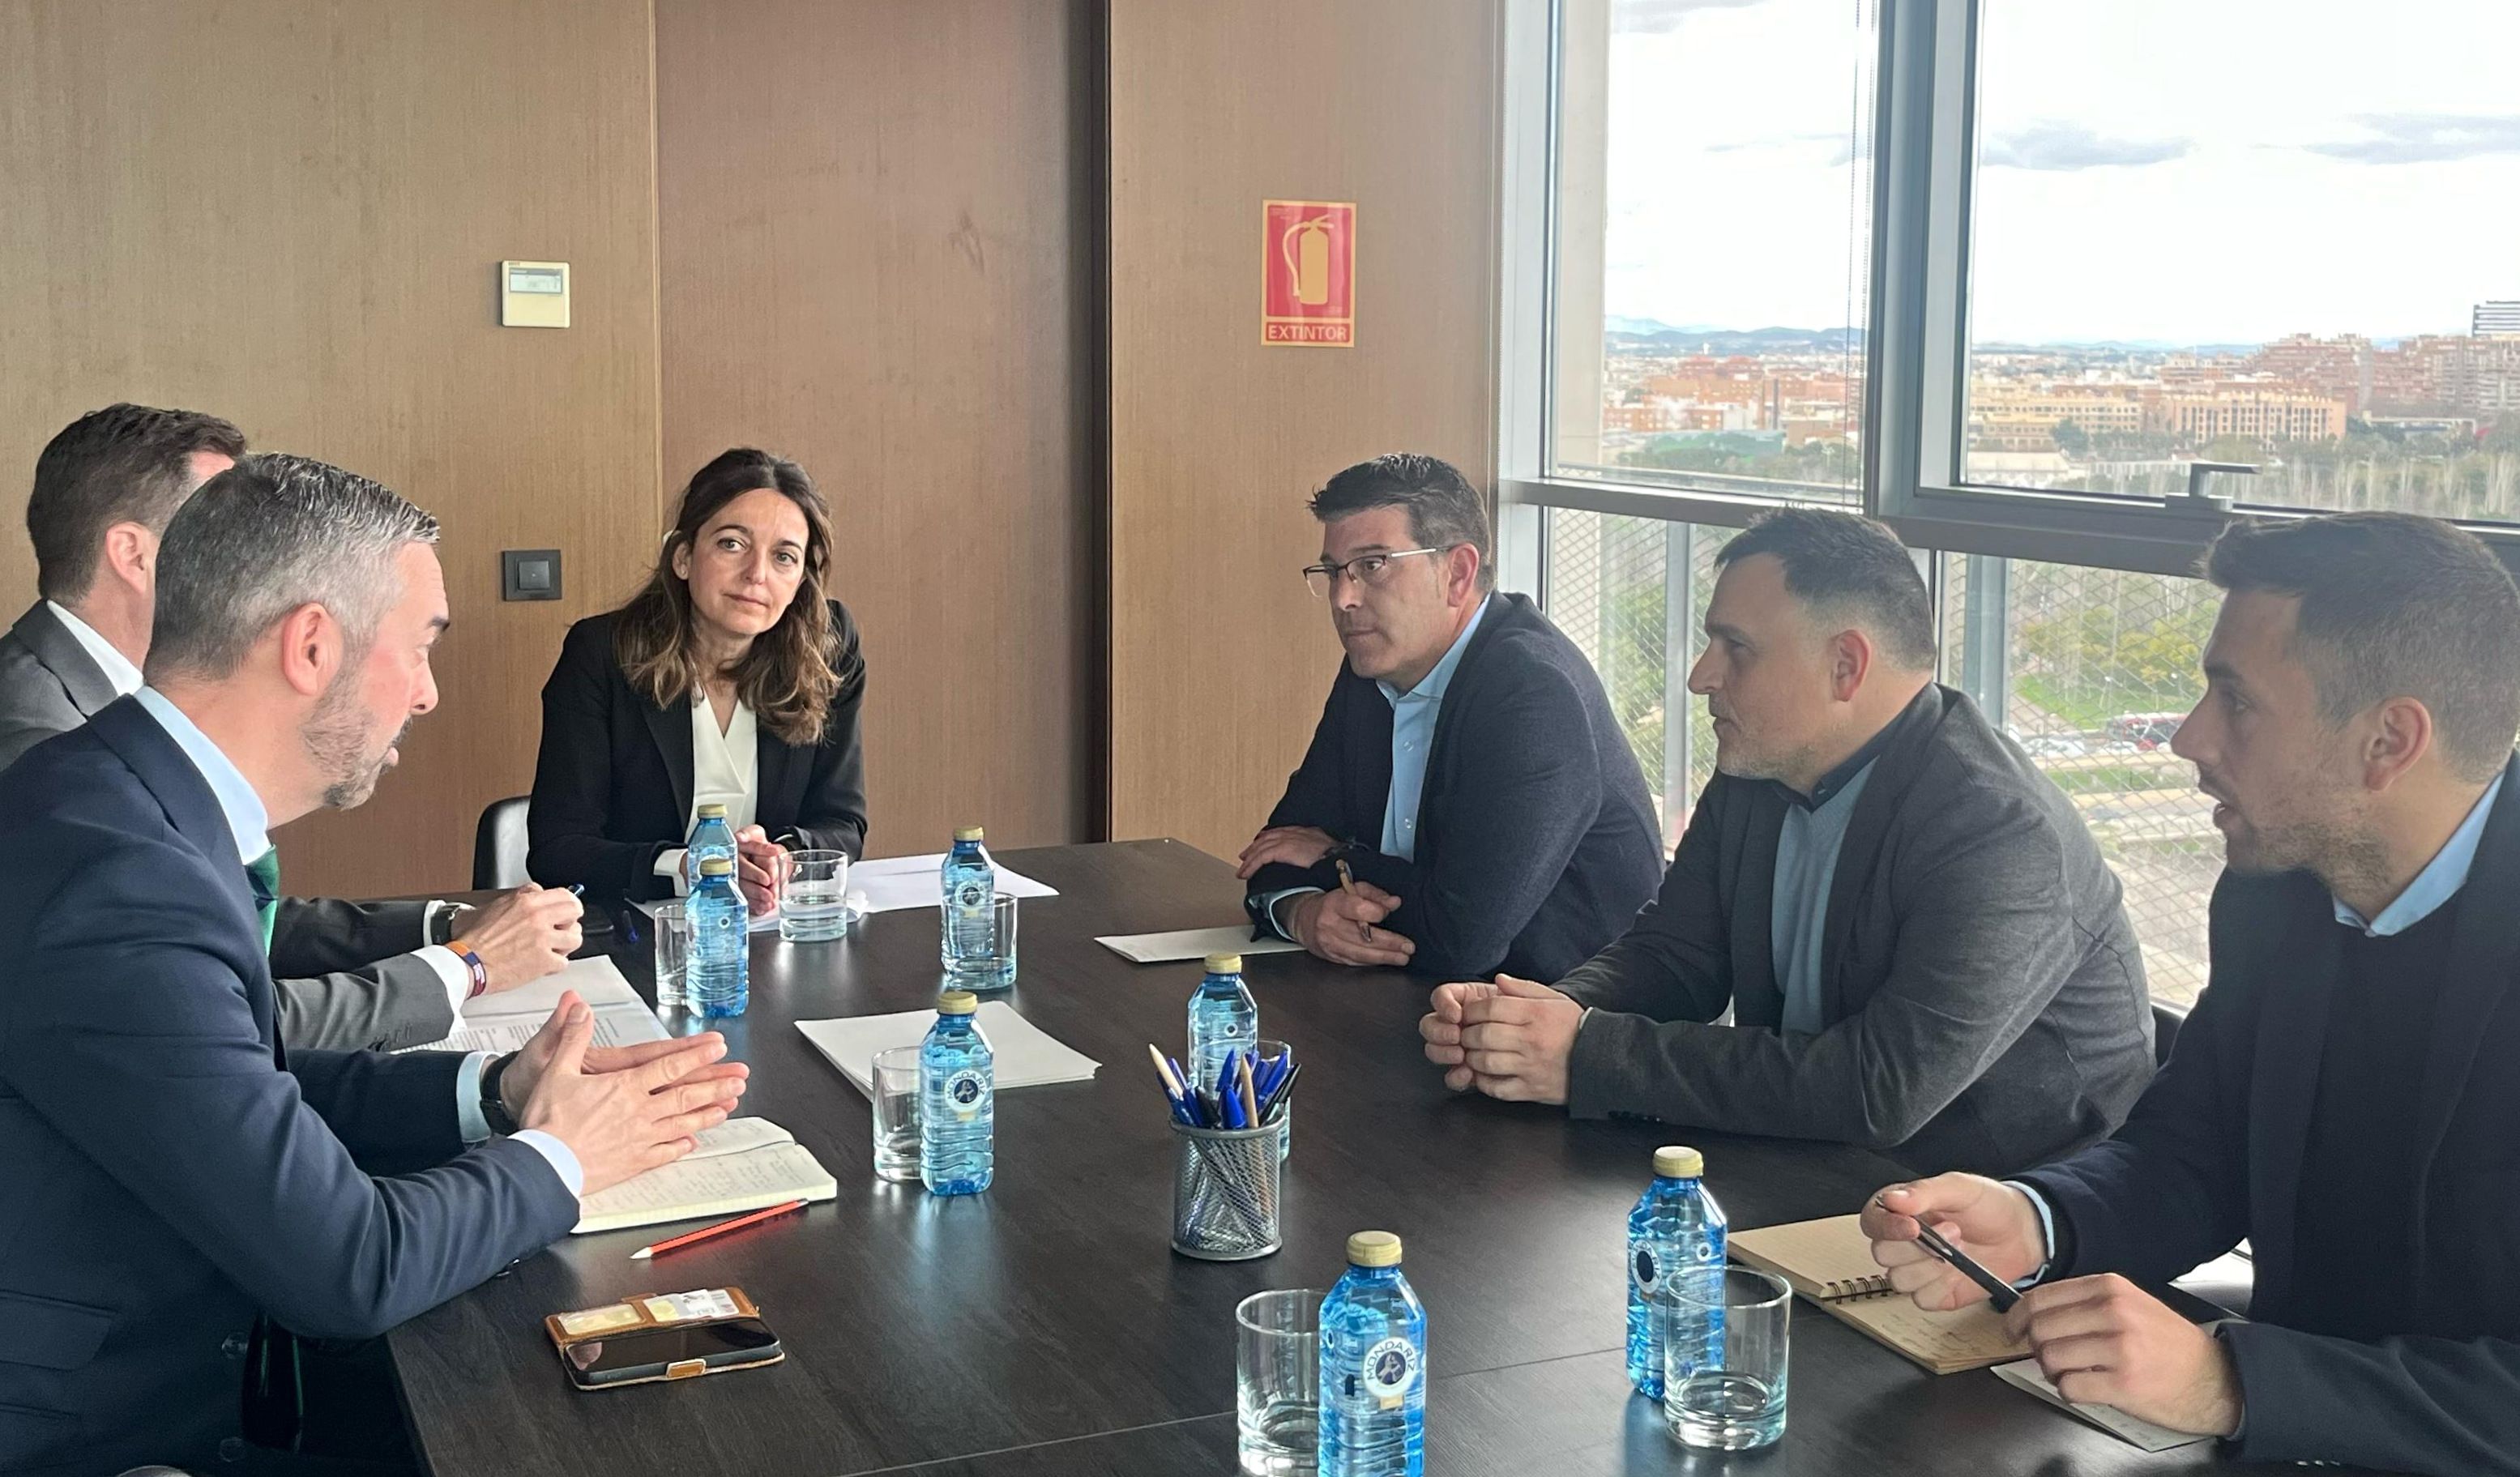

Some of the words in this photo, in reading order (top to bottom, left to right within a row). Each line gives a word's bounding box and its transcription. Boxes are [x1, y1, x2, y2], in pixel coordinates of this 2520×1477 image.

[1267, 324, 1348, 340] EXTINTOR
[946, 1071, 987, 1099] MONDARIZ
[1365, 1340, 1416, 1381] MONDARIZ
